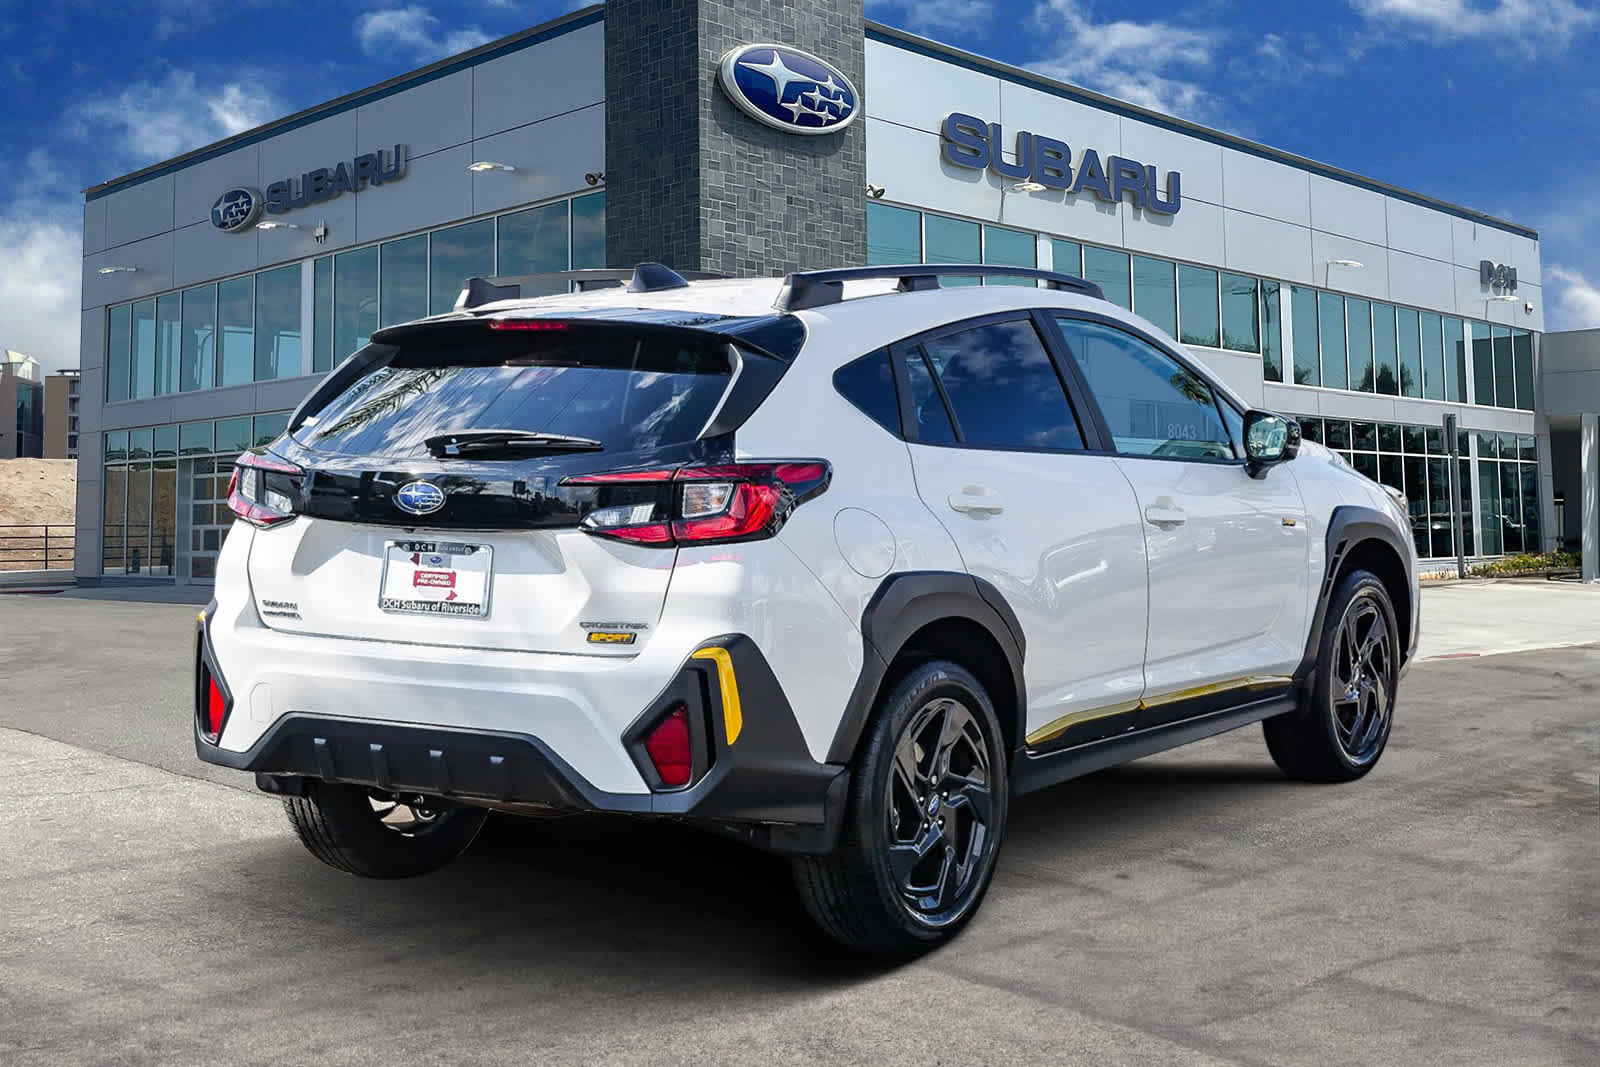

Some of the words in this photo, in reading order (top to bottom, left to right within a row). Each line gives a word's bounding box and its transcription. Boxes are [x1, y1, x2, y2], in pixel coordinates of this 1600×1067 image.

[942, 112, 1181, 215] SUBARU
[265, 143, 405, 215] SUBARU
[1167, 423, 1197, 440] 8043
[414, 543, 434, 552] DCH
[383, 599, 401, 609] DCH
[401, 600, 431, 611] Subaru
[431, 601, 441, 611] of
[441, 602, 480, 614] Riverside
[590, 632, 632, 642] SPORT
